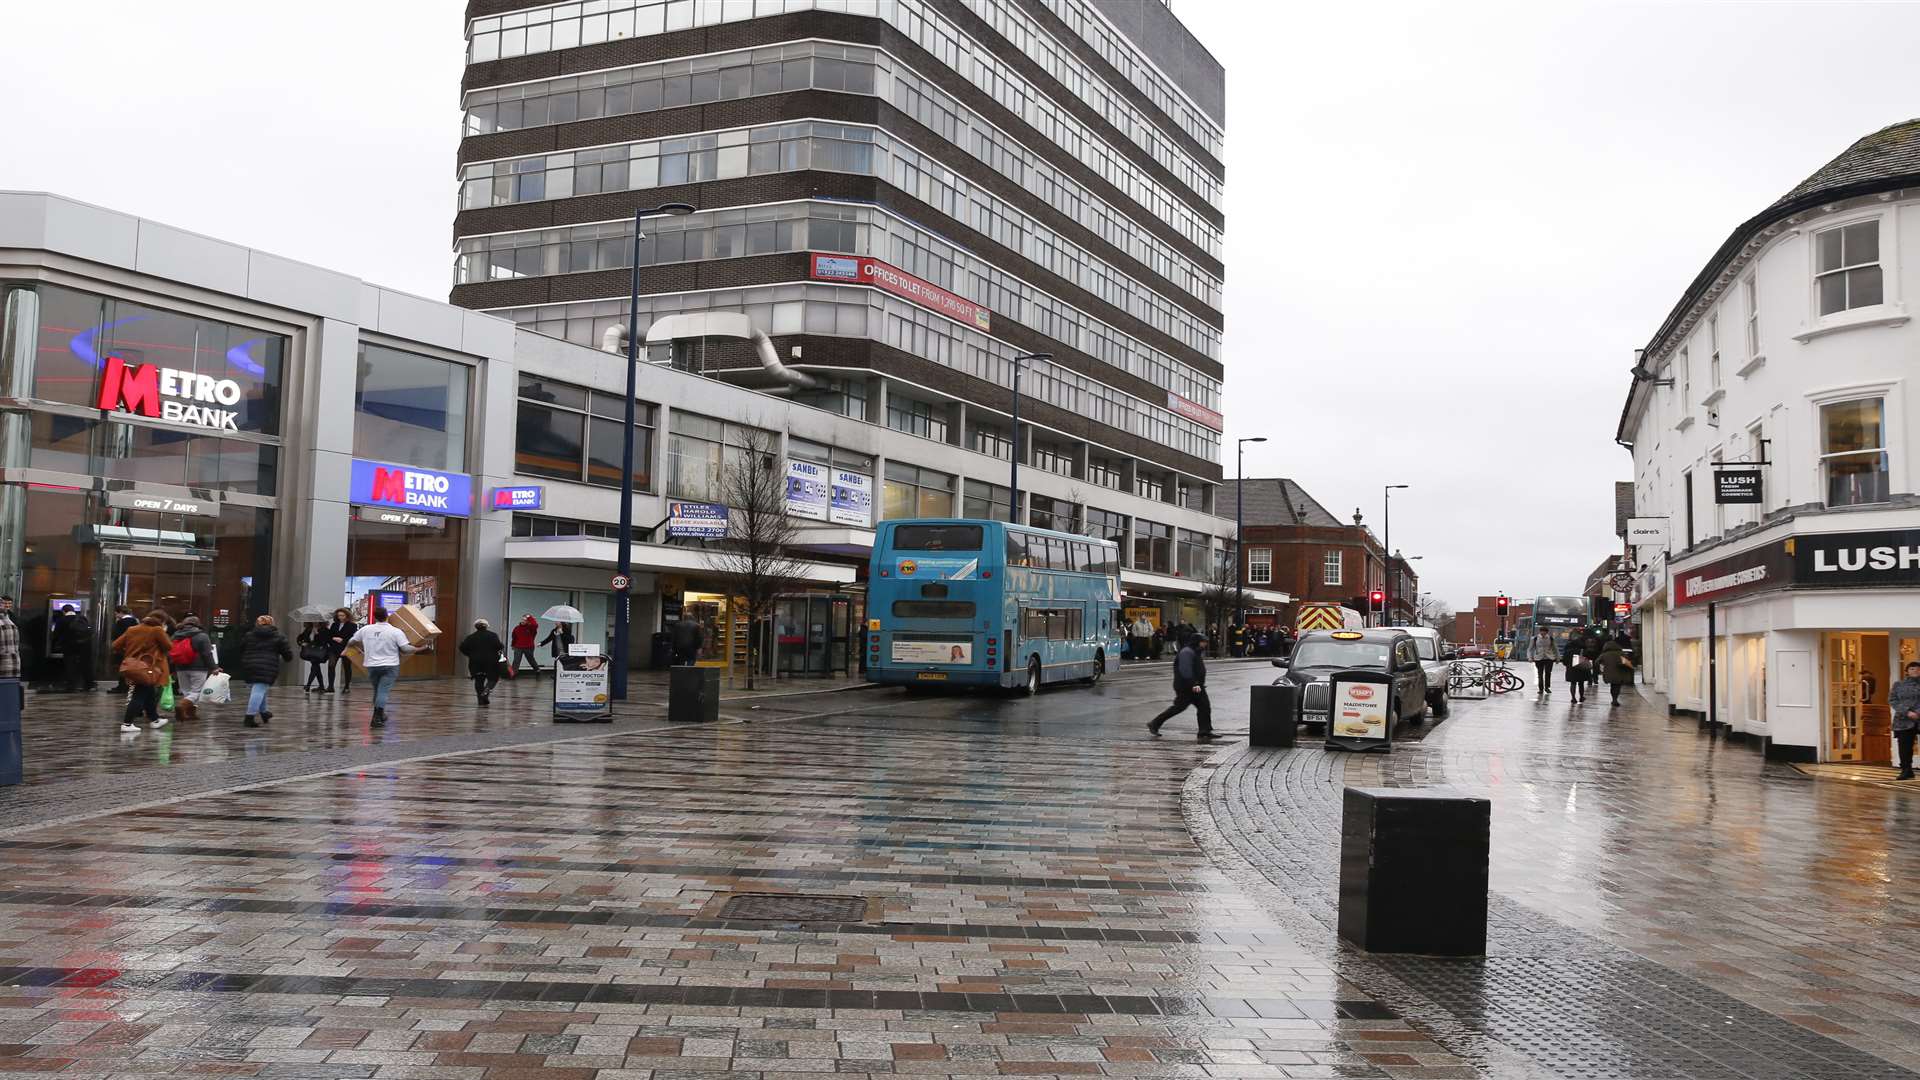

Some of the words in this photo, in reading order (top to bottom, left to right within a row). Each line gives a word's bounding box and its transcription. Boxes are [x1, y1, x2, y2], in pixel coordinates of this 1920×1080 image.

[864, 264, 898, 286] OFFICES
[899, 275, 908, 289] TO
[908, 278, 921, 295] LET
[921, 285, 940, 301] FROM
[97, 357, 241, 417] METRO
[162, 400, 239, 432] BANK
[372, 467, 449, 504] METRO
[1720, 476, 1756, 484] LUSH
[134, 499, 161, 509] OPEN
[163, 499, 173, 510] 7
[173, 503, 198, 513] DAYS
[405, 491, 448, 509] BANK
[495, 490, 536, 505] METRO
[381, 513, 401, 522] OPEN
[402, 513, 410, 523] 7
[410, 516, 428, 525] DAYS
[1815, 546, 1920, 573] LUSH
[614, 578, 626, 586] 20
